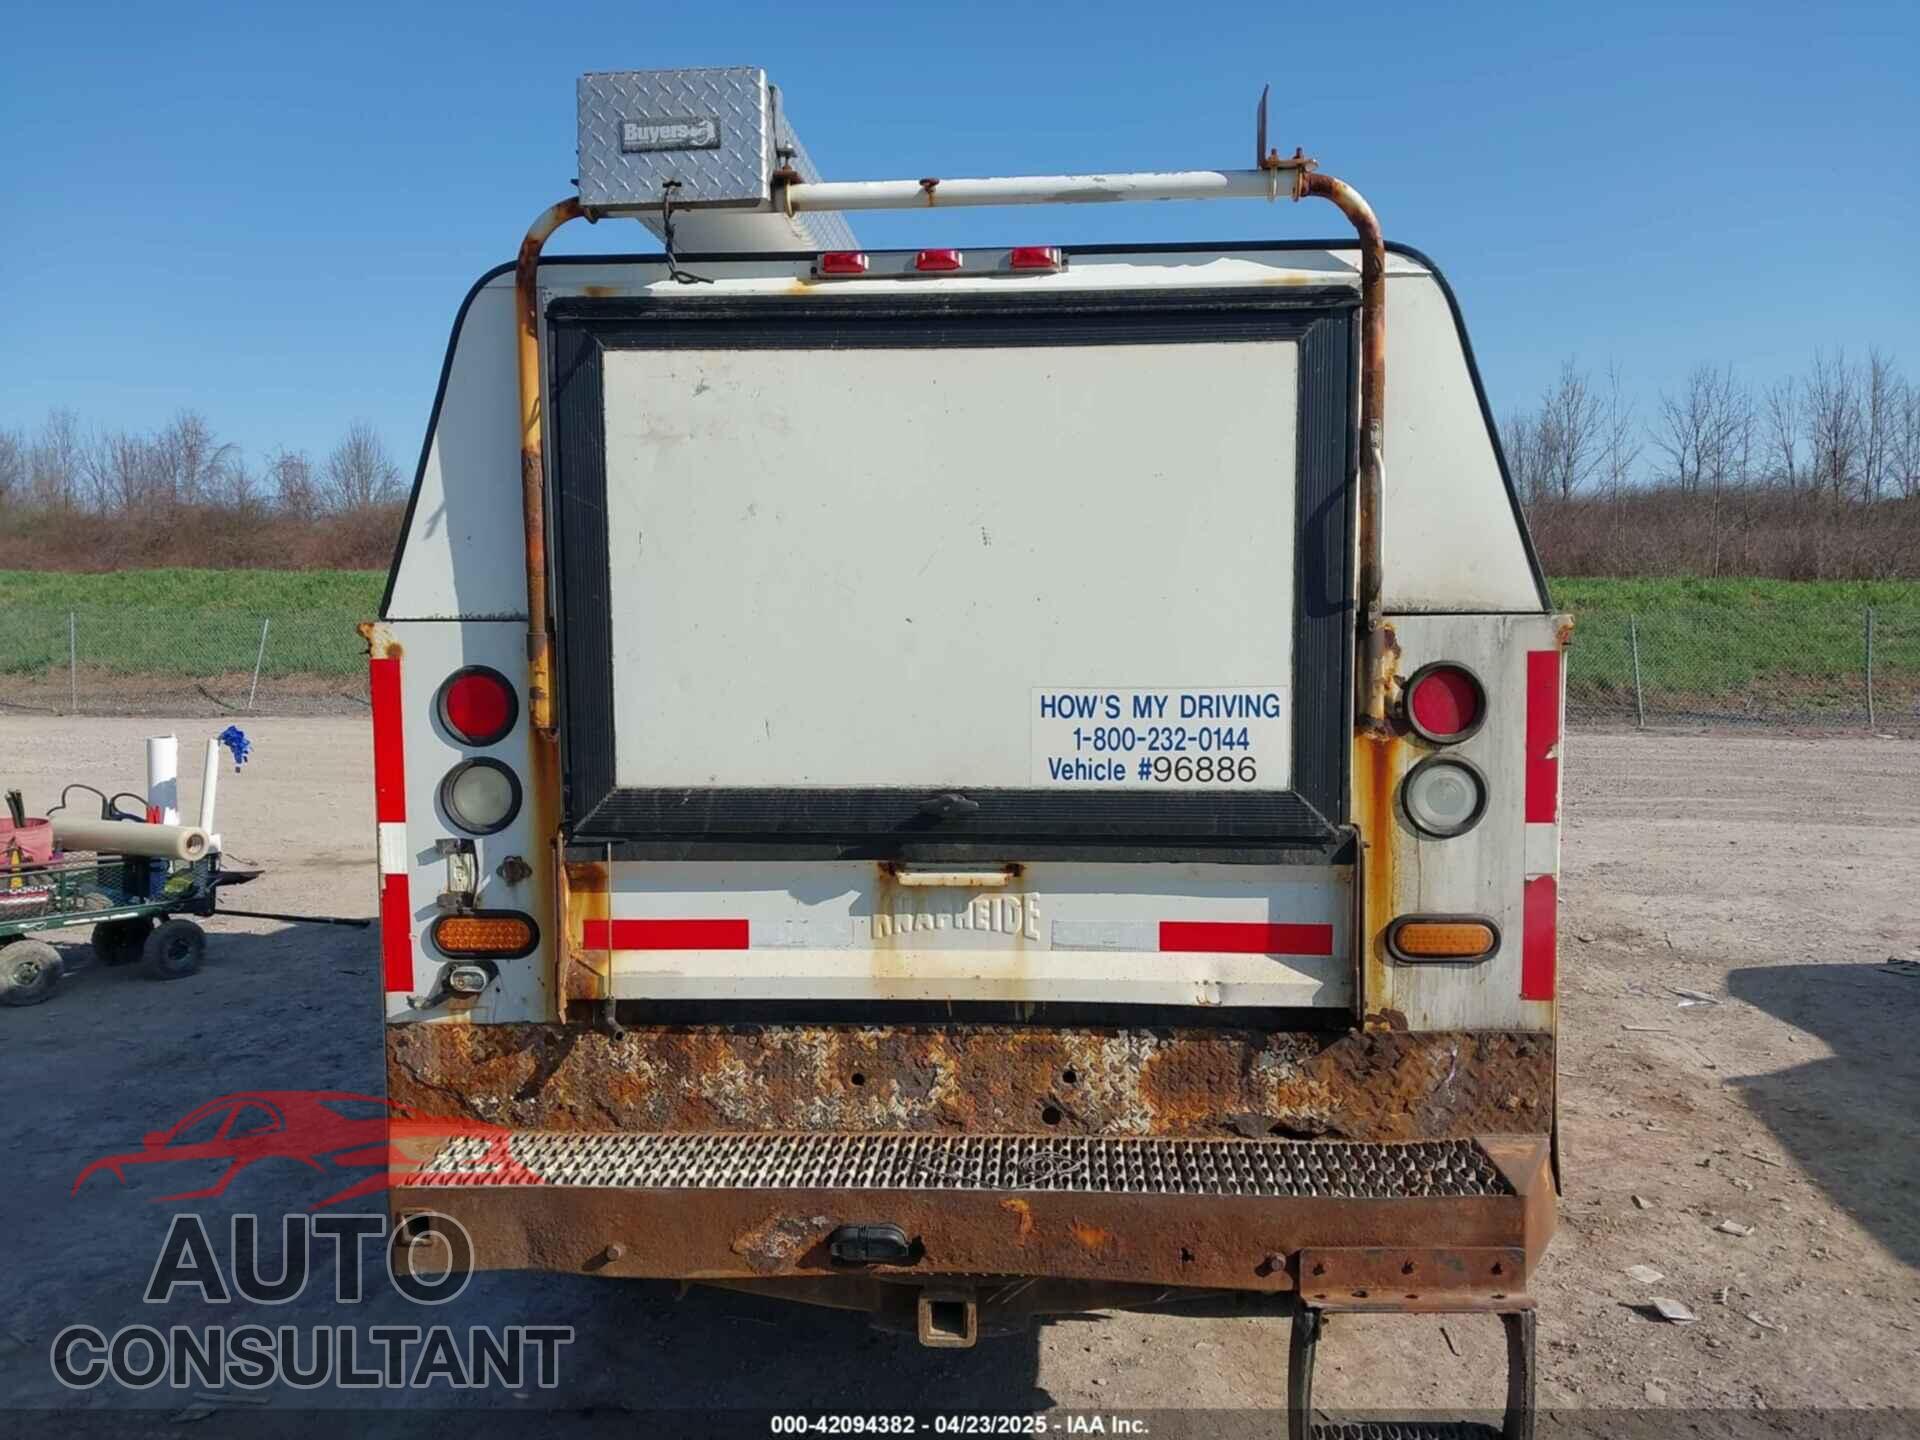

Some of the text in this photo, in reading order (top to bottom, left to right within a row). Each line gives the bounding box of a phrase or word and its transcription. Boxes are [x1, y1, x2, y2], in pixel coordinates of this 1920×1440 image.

[624, 123, 688, 143] Buyers
[1040, 693, 1280, 719] HOW'S MY DRIVING
[1073, 726, 1250, 751] 1-800-232-0144
[1048, 756, 1257, 782] Vehicle #96886
